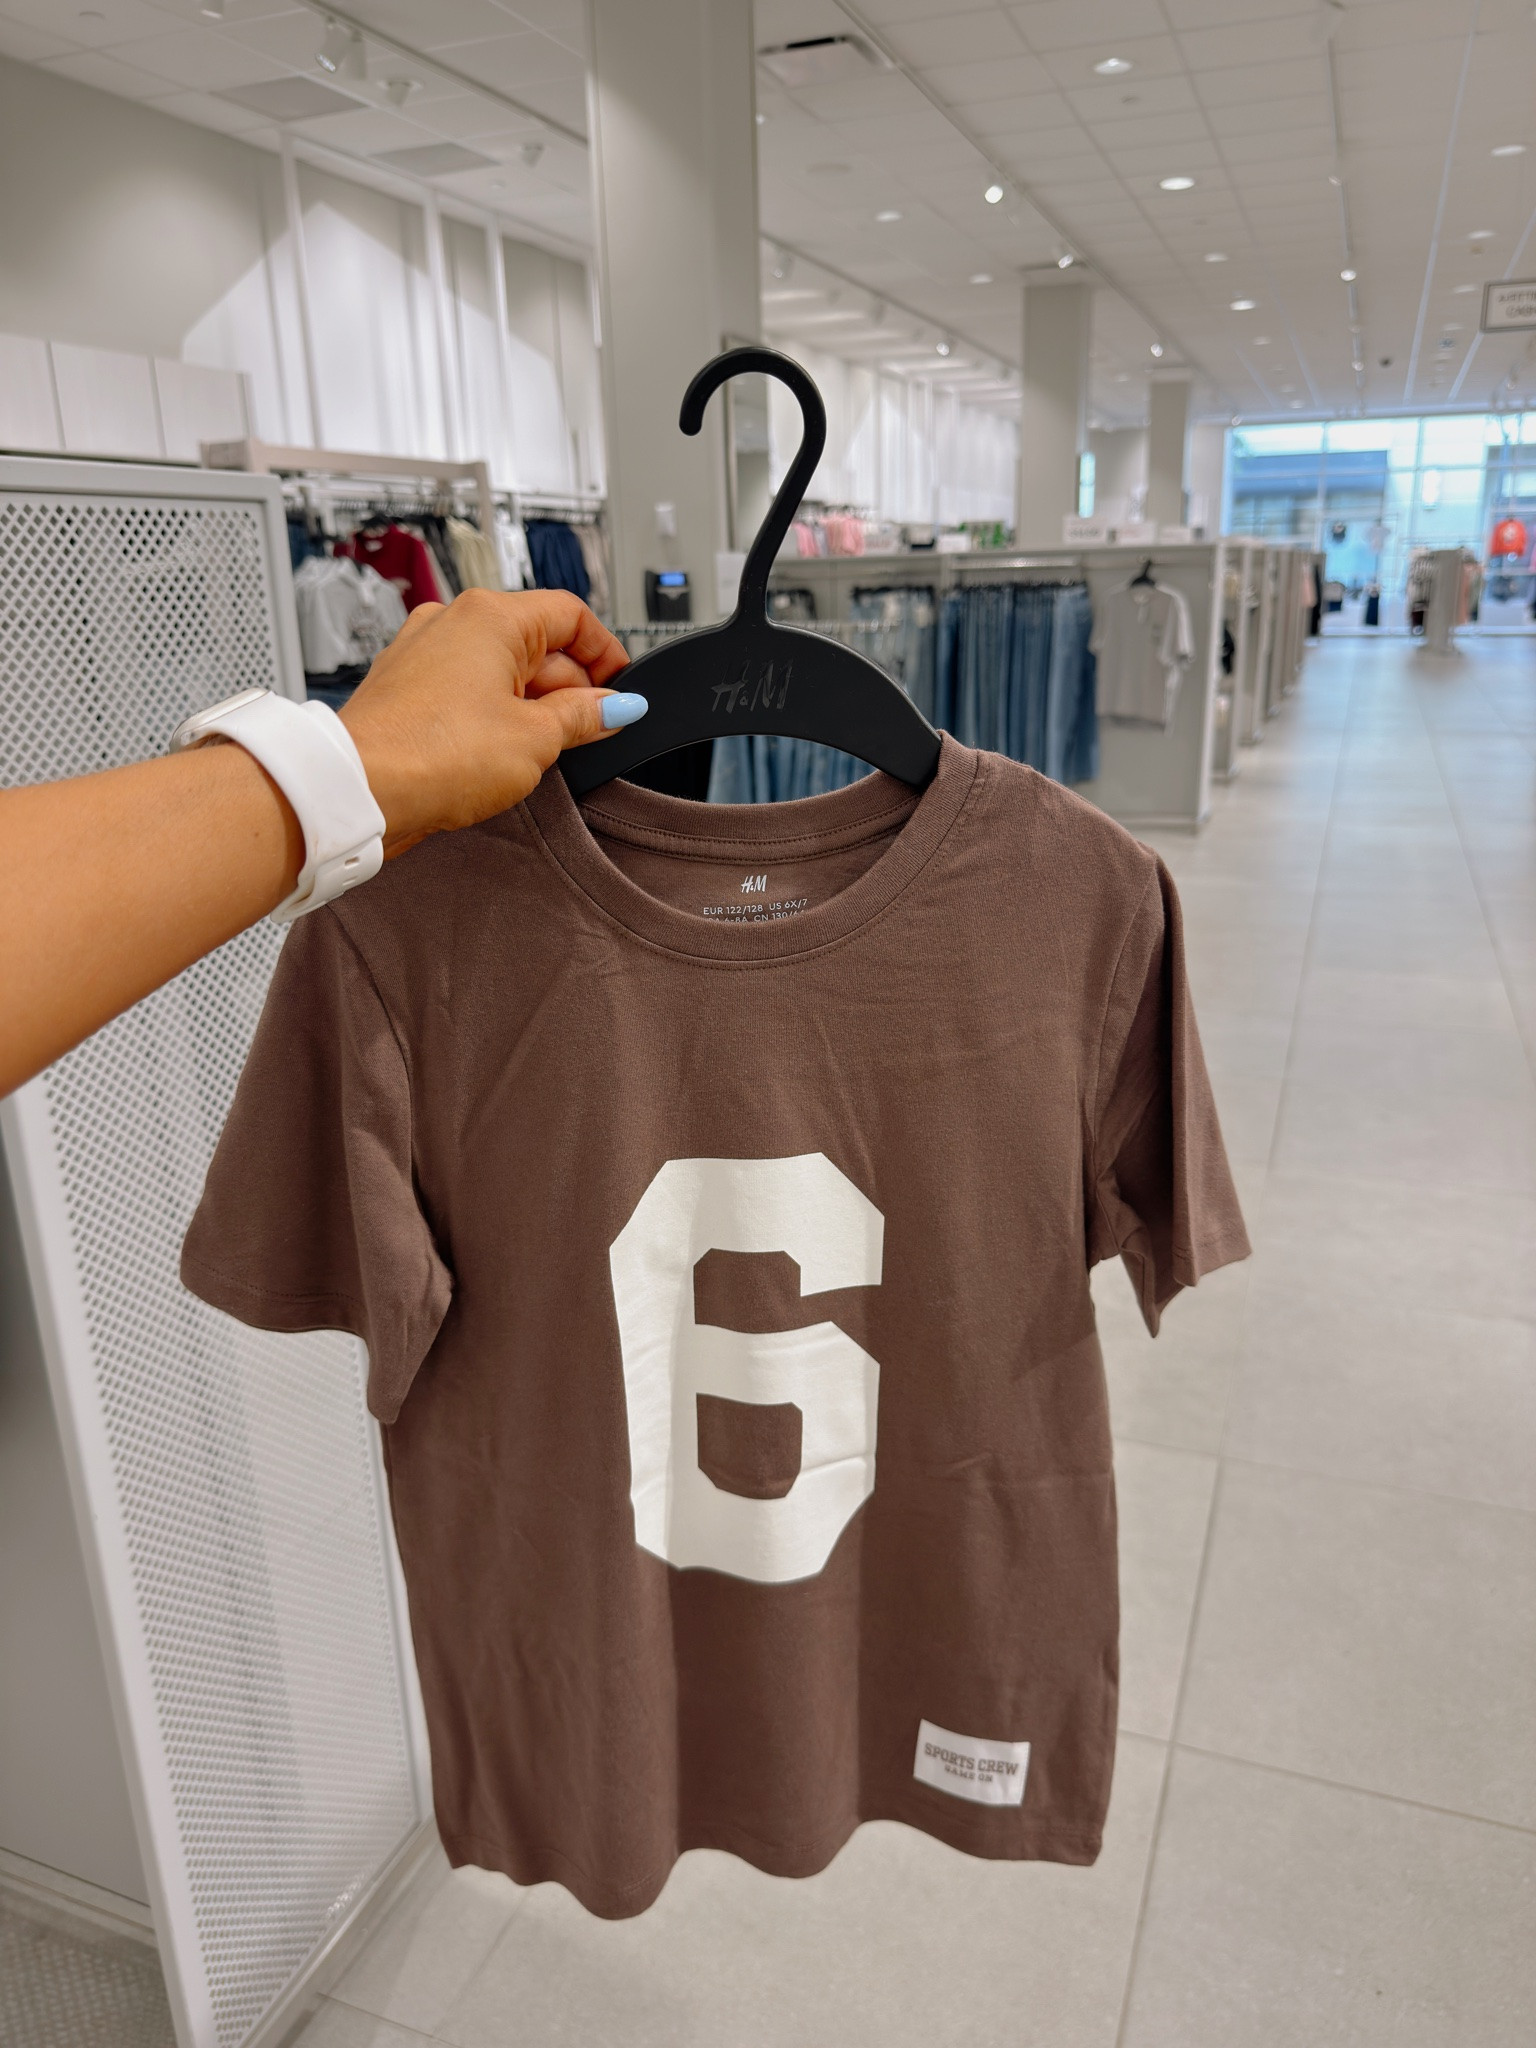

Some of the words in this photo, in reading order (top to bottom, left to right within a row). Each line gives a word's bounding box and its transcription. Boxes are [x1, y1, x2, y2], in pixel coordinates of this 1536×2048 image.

[710, 658, 793, 714] H&M
[741, 875, 767, 893] H&M
[703, 906, 724, 915] EUR
[726, 904, 764, 915] 122/128
[769, 902, 782, 911] US
[784, 898, 808, 909] 6X/7
[753, 913, 769, 922] CN
[609, 1152, 885, 1586] 6
[924, 1742, 975, 1770] SPORTS
[977, 1758, 1019, 1776] CREW
